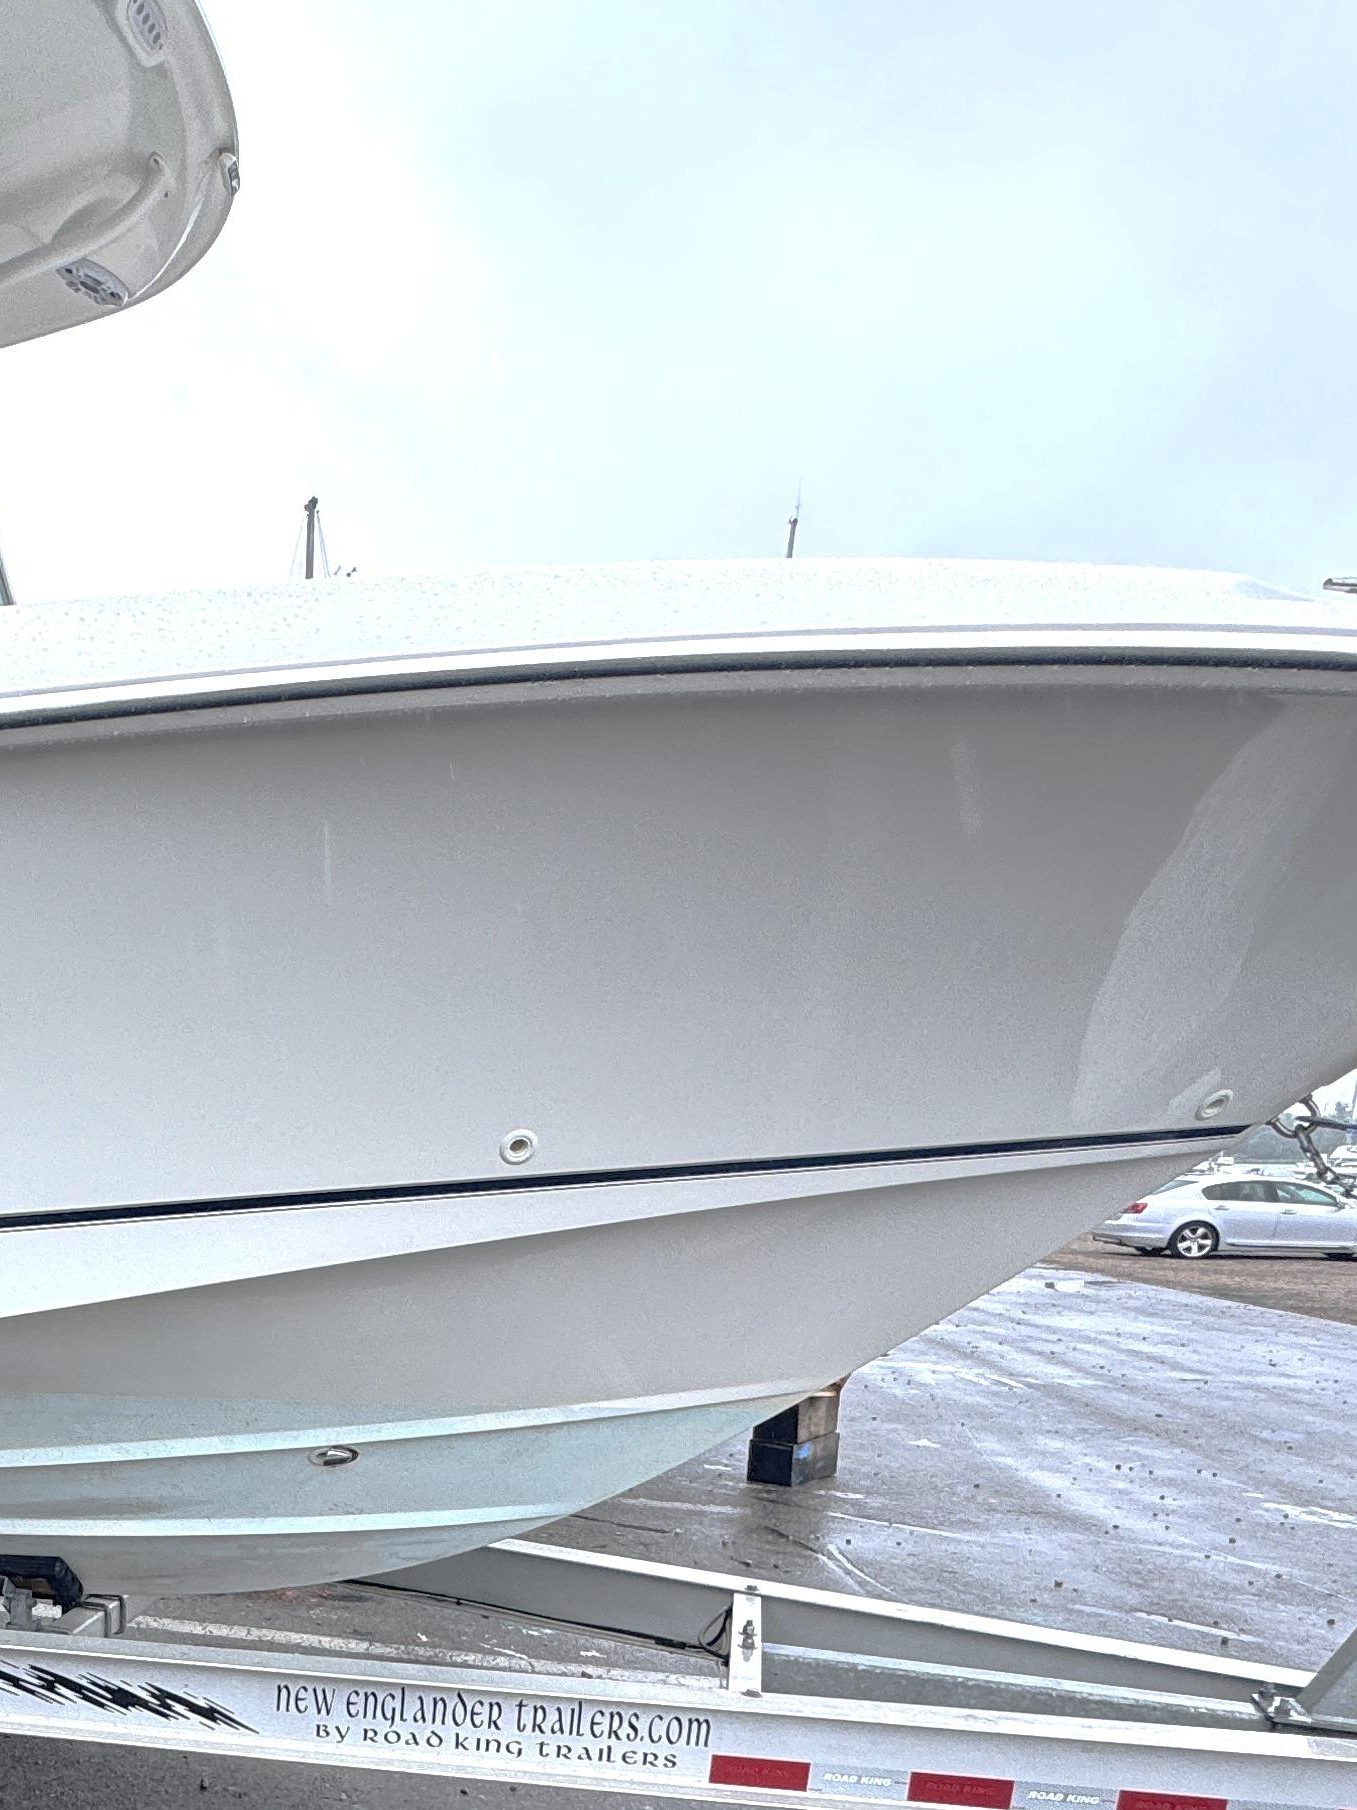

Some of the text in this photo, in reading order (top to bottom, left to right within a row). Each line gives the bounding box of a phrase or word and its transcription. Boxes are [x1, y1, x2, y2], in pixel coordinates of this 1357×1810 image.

[823, 1772, 892, 1787] ROAD KING
[1027, 1790, 1101, 1806] ROAD KING
